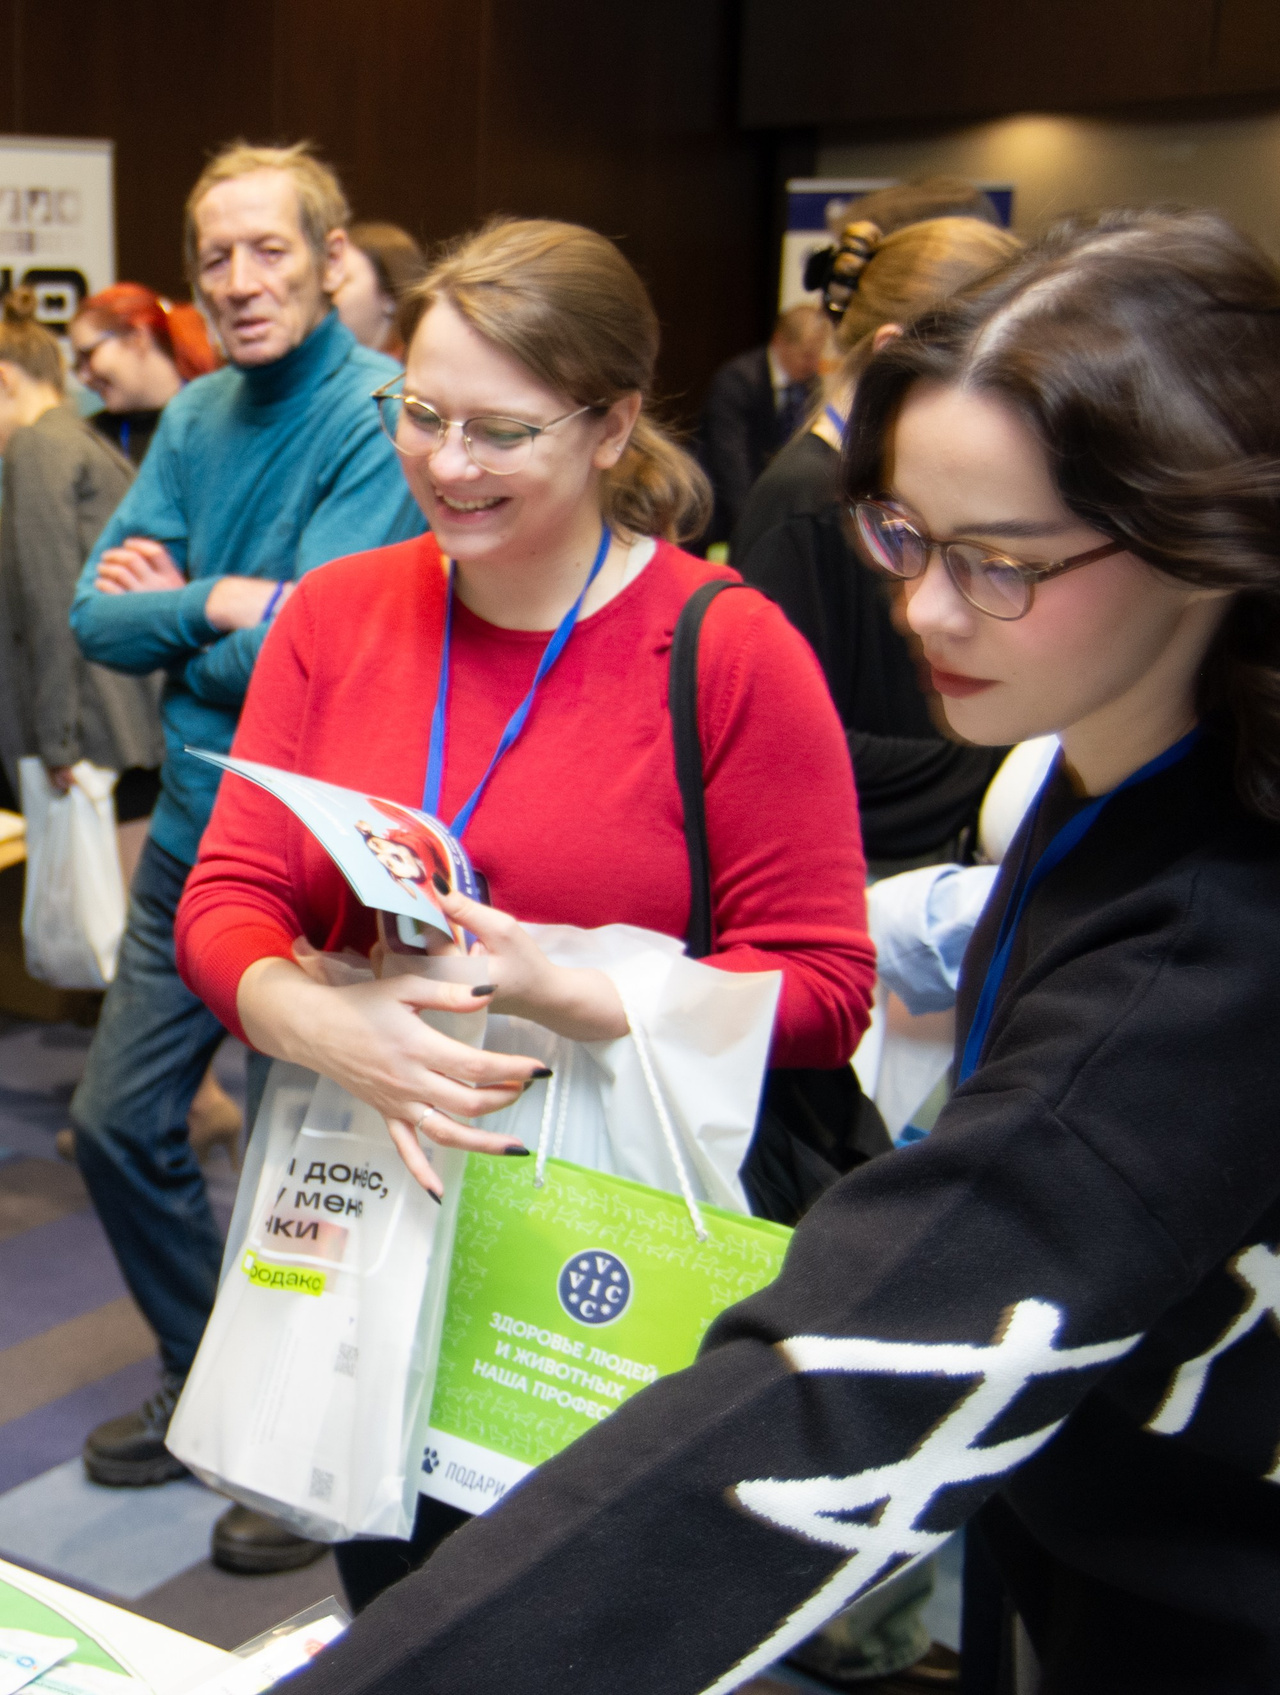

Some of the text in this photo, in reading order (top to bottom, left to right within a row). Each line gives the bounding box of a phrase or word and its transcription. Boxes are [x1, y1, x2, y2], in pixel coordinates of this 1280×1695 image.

[472, 1358, 528, 1393] НАША
[489, 1312, 659, 1384] ЗДОРОВЬЕ ЛЮДЕЙ
[494, 1340, 627, 1401] И ЖИВОТНЫХ
